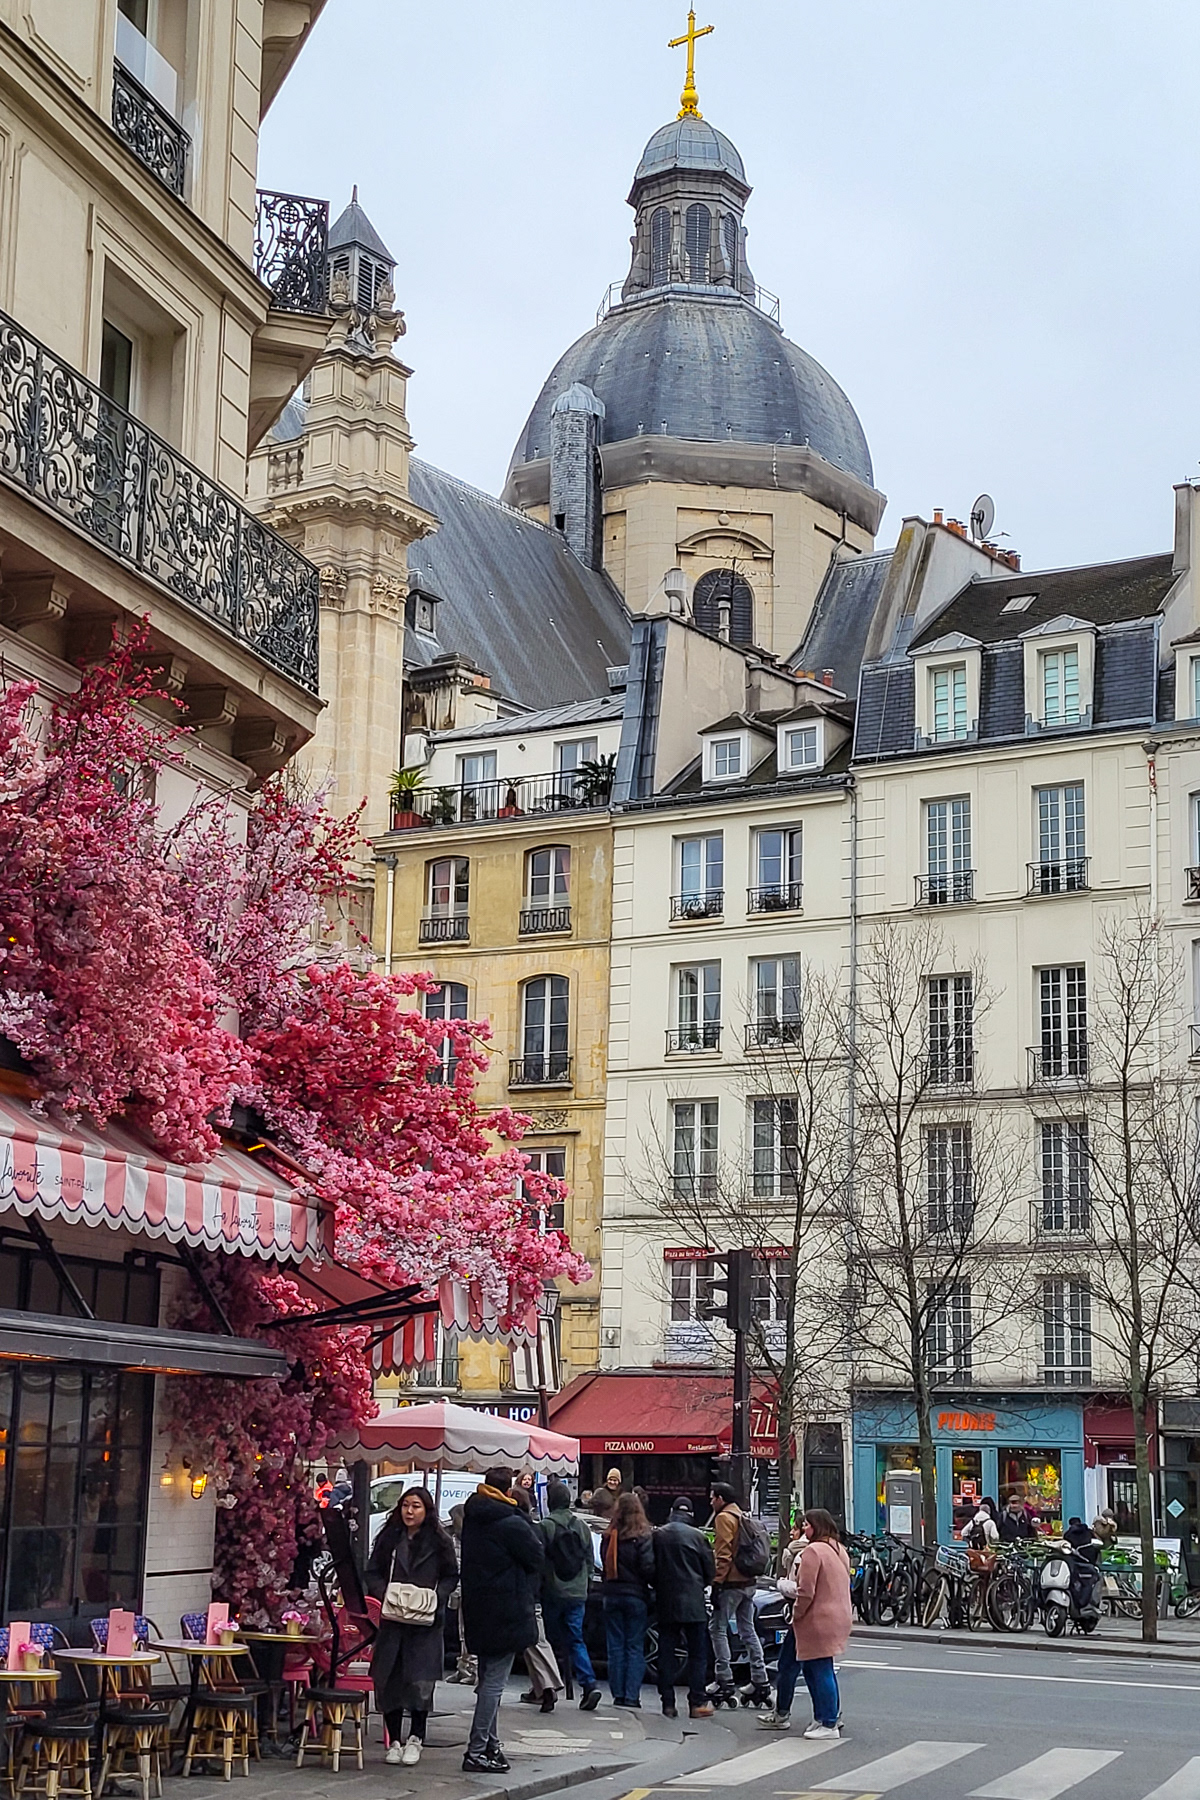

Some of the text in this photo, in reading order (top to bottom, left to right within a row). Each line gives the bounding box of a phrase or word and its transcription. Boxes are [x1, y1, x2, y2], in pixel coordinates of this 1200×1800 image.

[509, 1407, 537, 1421] HO
[605, 1441, 655, 1451] PIZZA MOMO
